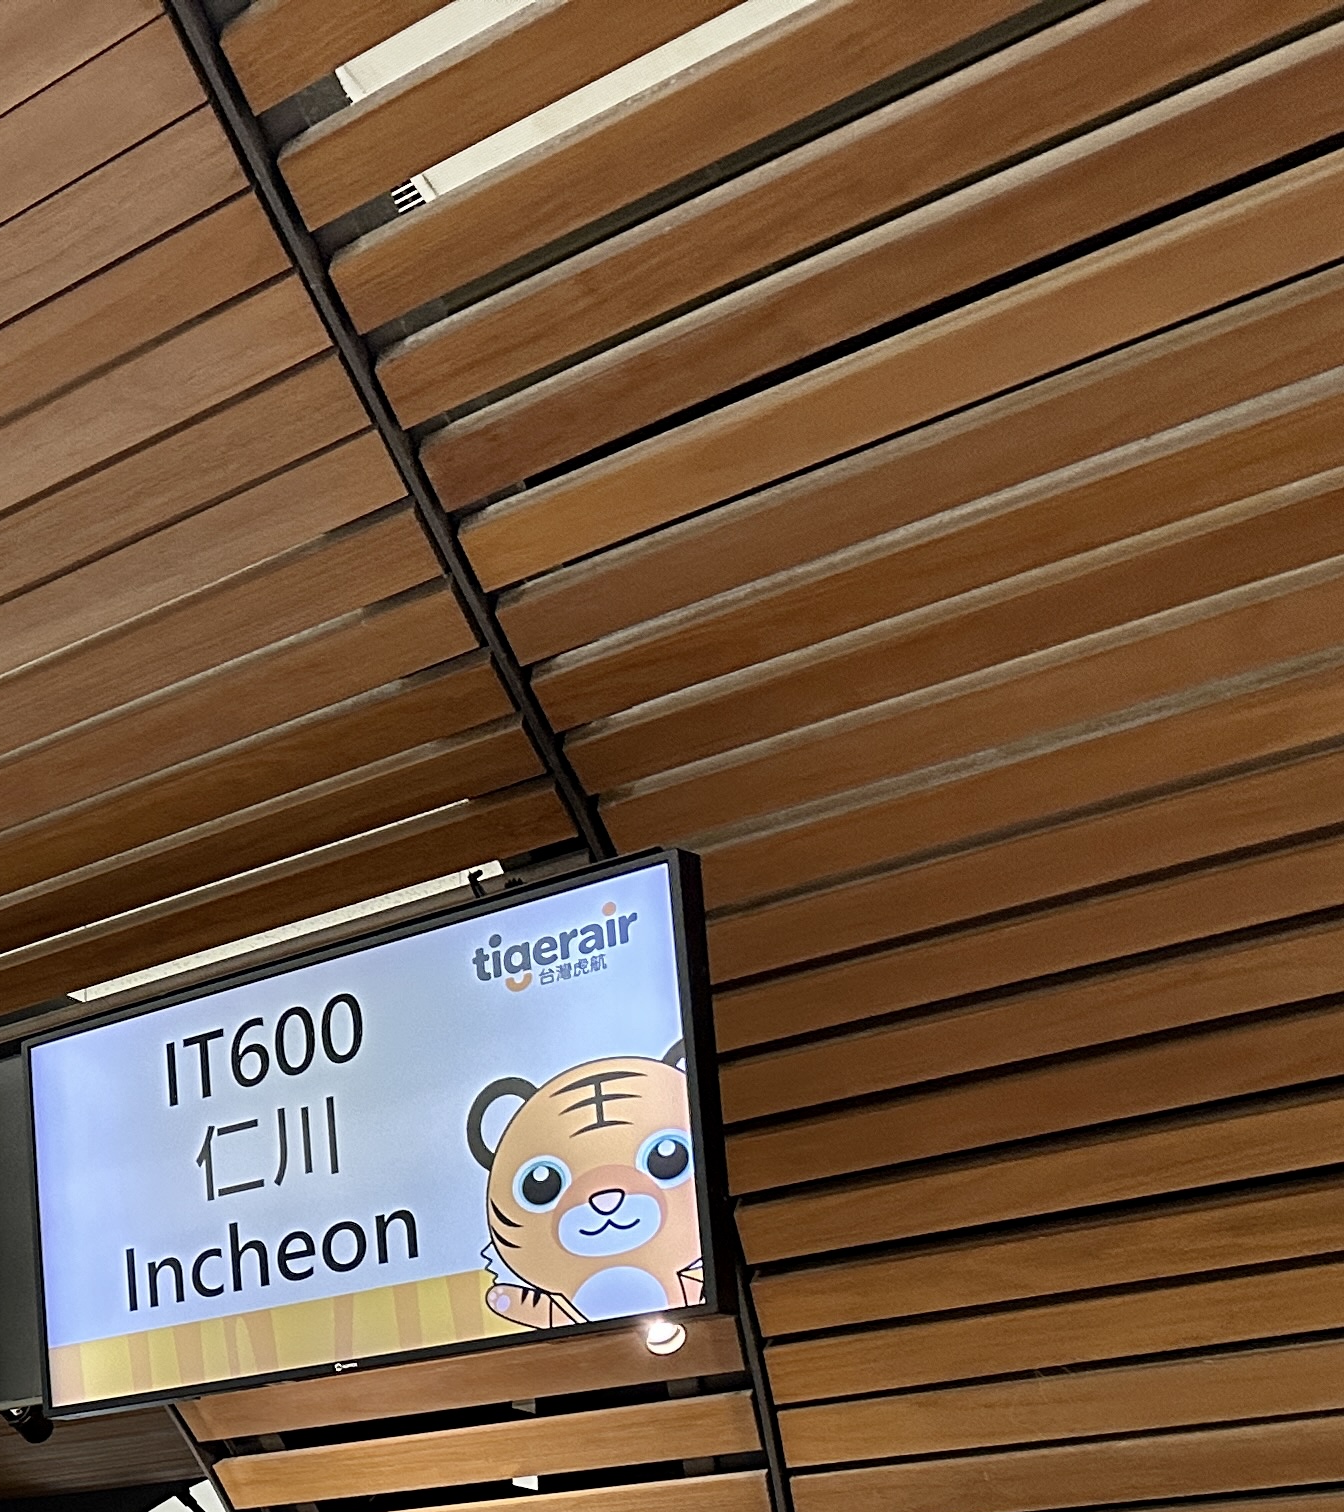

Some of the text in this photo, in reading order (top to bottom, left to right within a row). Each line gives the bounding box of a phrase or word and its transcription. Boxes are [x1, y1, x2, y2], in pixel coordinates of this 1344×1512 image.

[472, 902, 638, 993] tigerair
[539, 953, 607, 985] 台灣虎航
[167, 992, 363, 1108] IT600
[196, 1095, 340, 1202] 仁川
[126, 1206, 419, 1313] Incheon
